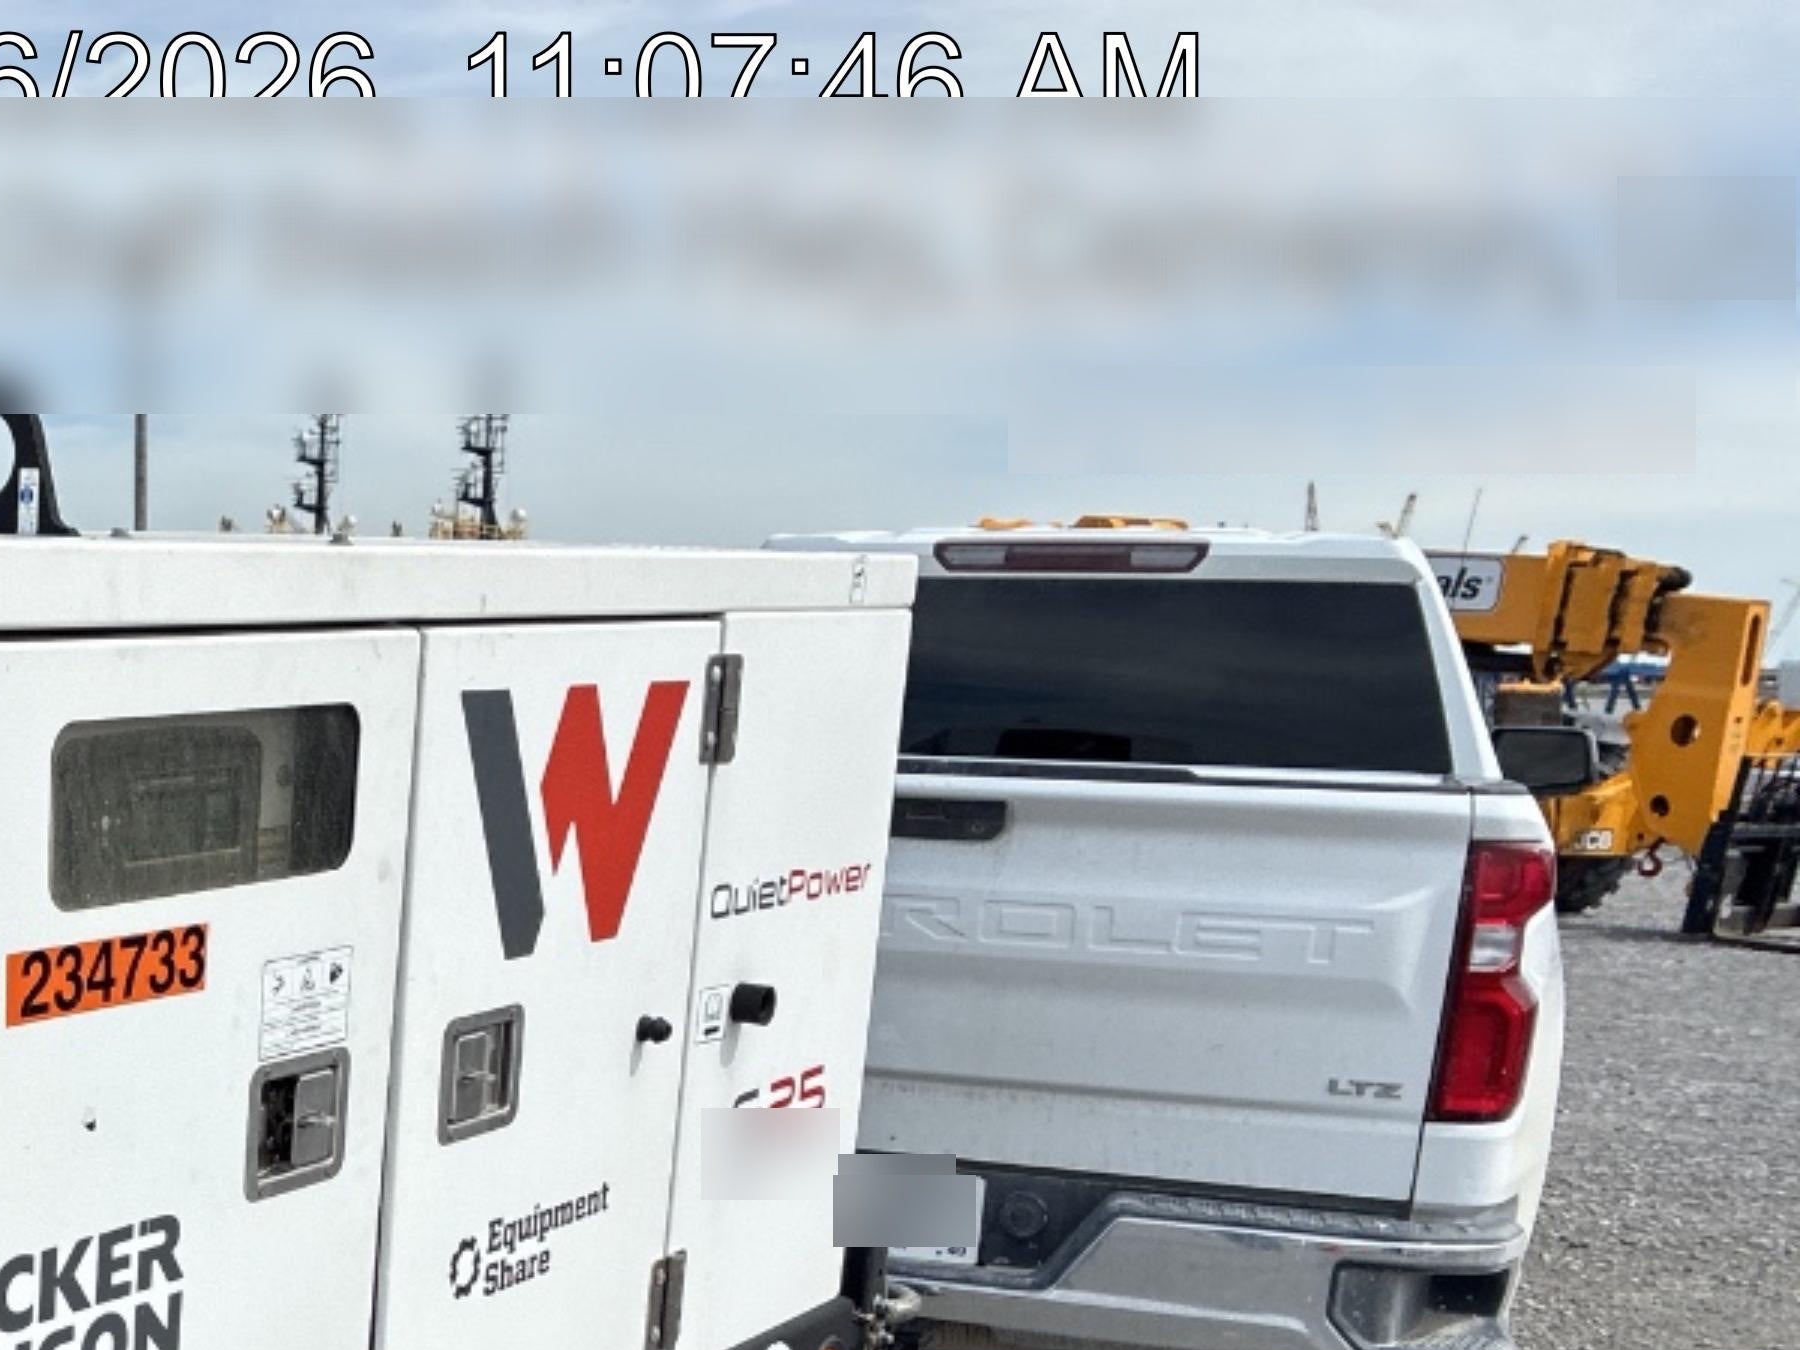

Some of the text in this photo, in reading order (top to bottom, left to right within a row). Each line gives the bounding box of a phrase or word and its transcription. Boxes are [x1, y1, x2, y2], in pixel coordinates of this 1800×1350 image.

[710, 863, 872, 920] QuietPower
[20, 924, 205, 1018] 234733
[1327, 1079, 1404, 1099] LTZ
[486, 1181, 610, 1255] Equipment
[482, 1249, 551, 1297] Share
